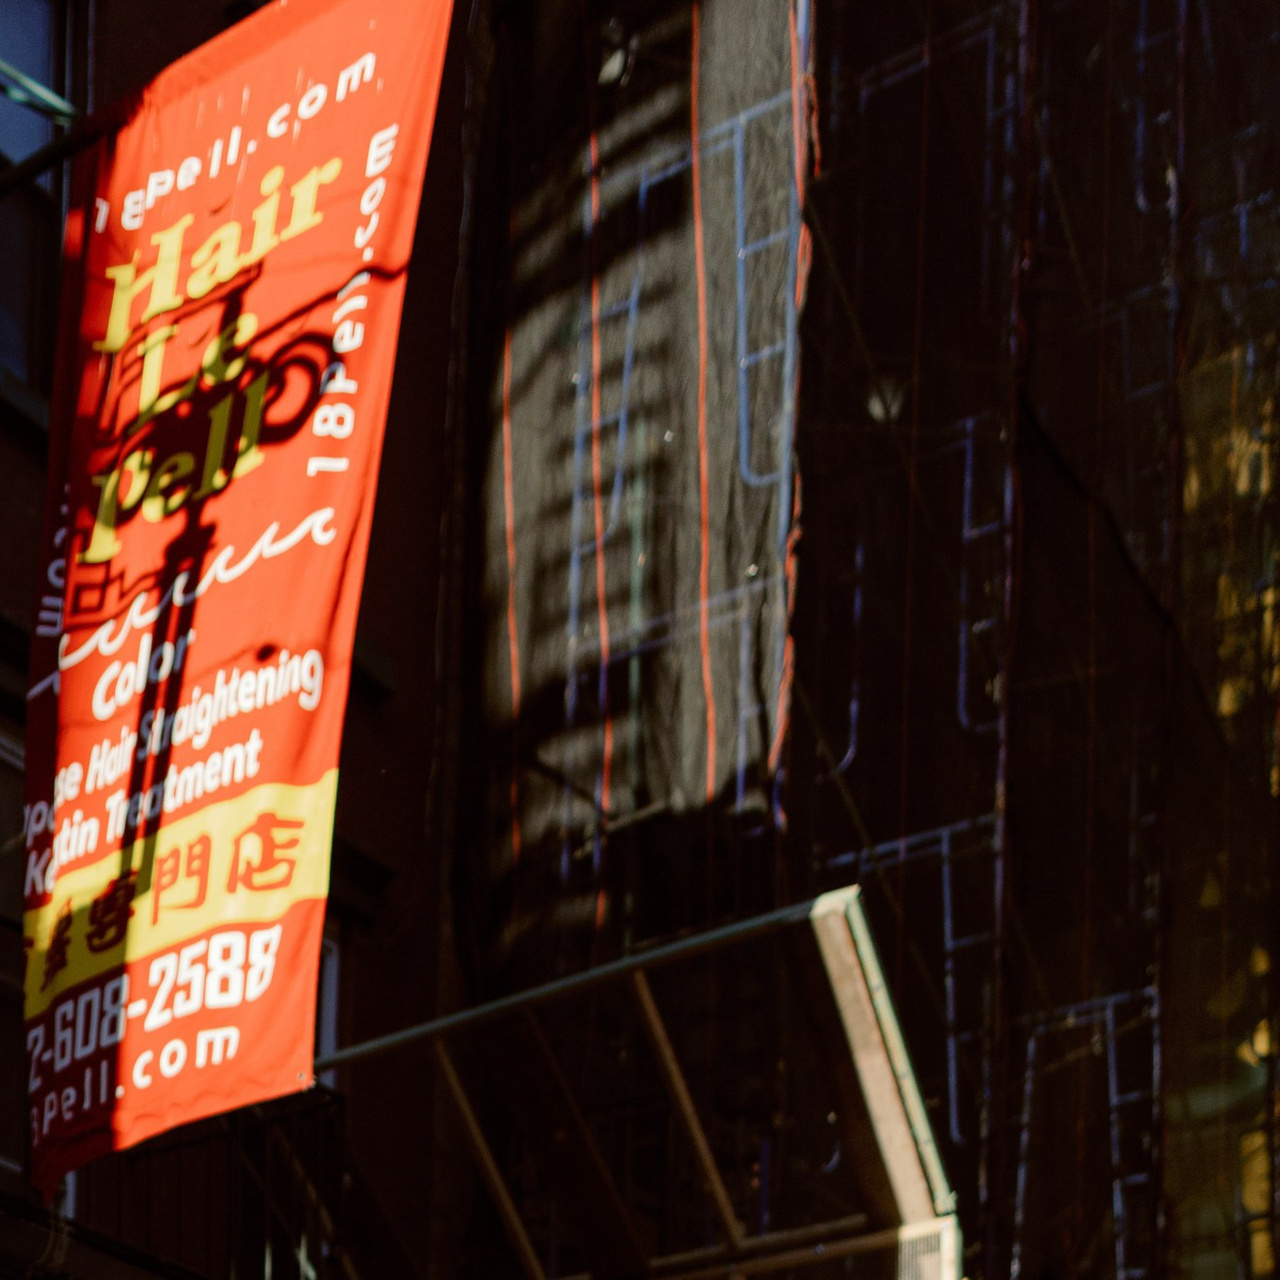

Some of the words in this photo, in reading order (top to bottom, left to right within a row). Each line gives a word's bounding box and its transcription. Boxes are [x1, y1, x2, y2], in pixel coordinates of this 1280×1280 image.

[93, 157, 342, 352] Hair
[85, 725, 137, 793] Hair
[137, 649, 324, 760] Straightening
[92, 628, 196, 720] Color
[105, 728, 263, 844] Treatment
